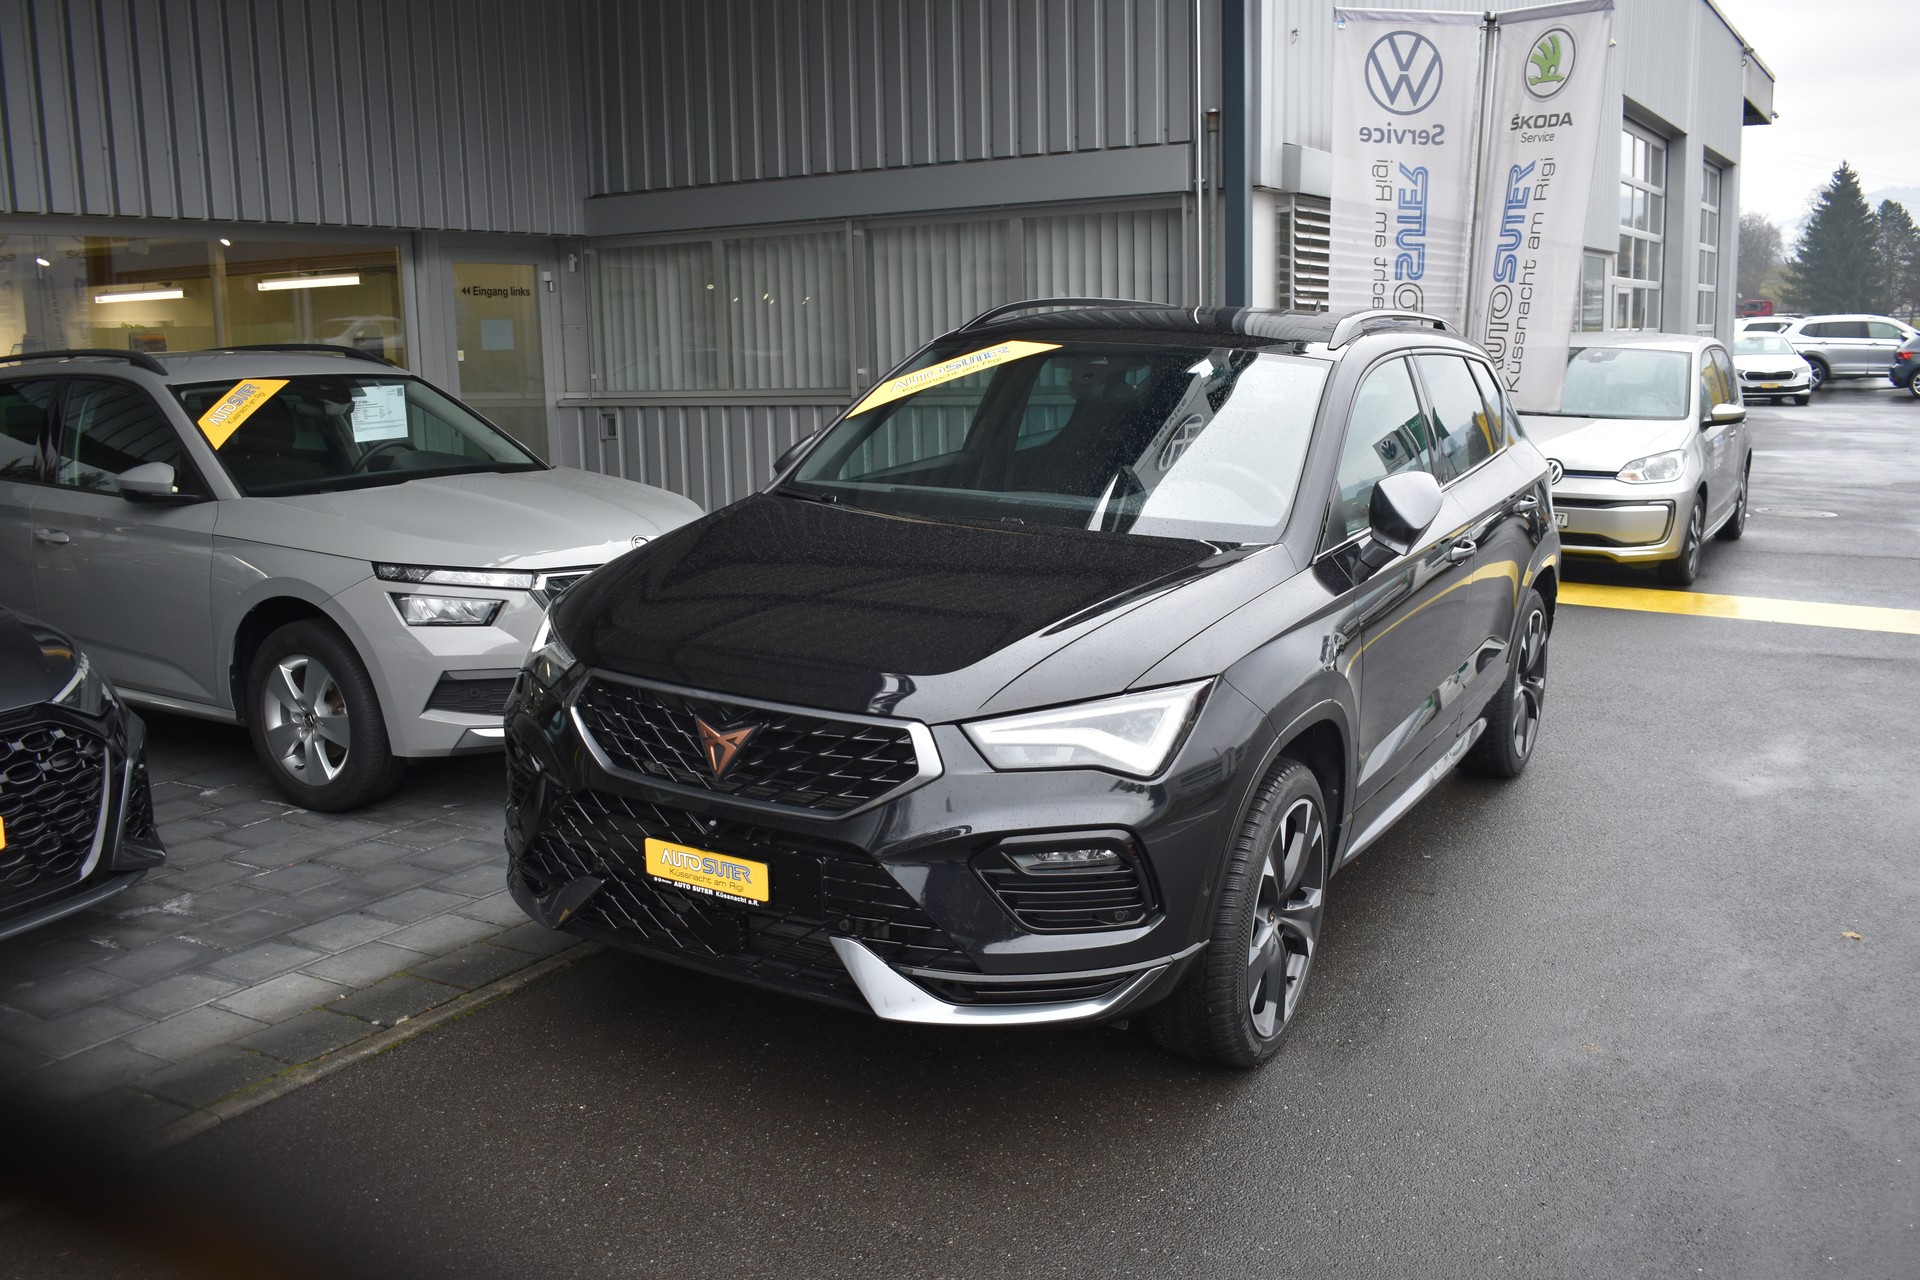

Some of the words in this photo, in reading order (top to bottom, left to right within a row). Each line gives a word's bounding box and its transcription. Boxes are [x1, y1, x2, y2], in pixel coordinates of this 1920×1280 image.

[1510, 112, 1573, 131] ŠKODA
[1520, 132, 1555, 144] Service
[1533, 157, 1556, 201] Rigi
[1528, 211, 1545, 250] am
[472, 286, 508, 298] Eingang
[510, 286, 531, 297] links
[1506, 259, 1537, 393] Küssnacht
[669, 868, 712, 884] Küssnacht
[713, 878, 727, 888] am
[729, 882, 745, 893] Rigi
[673, 881, 691, 890] AUTO
[692, 885, 714, 896] SUTER
